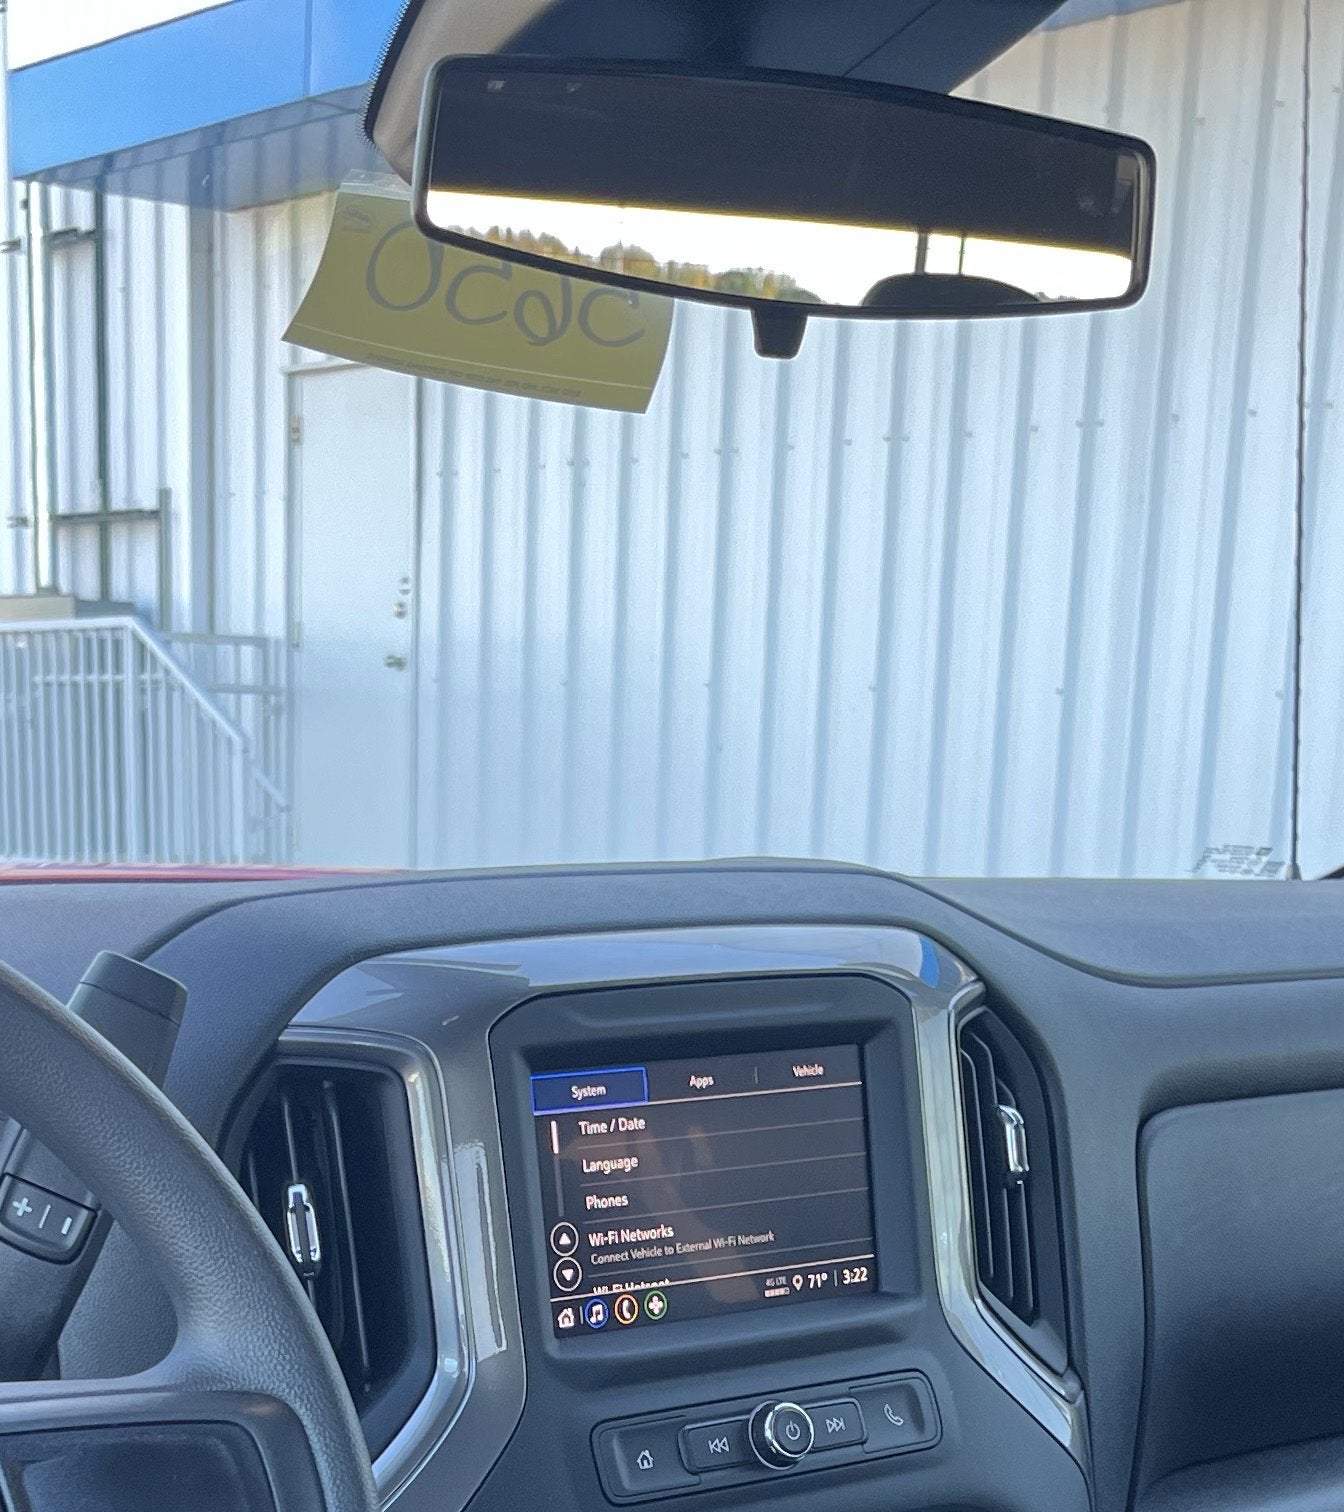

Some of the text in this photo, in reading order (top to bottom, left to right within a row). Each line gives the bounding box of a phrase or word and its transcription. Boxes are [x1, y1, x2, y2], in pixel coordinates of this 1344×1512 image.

[792, 1063, 825, 1077] Vehicle
[689, 1074, 714, 1089] Apps
[571, 1084, 607, 1100] System
[578, 1116, 646, 1135] Time / Date
[582, 1156, 639, 1176] Language
[585, 1193, 629, 1210] Phones
[588, 1223, 674, 1247] Wi-Fi Networks
[591, 1230, 775, 1265] Connect Vehicle to External Wi-Fi Network
[842, 1267, 868, 1284] 3:22
